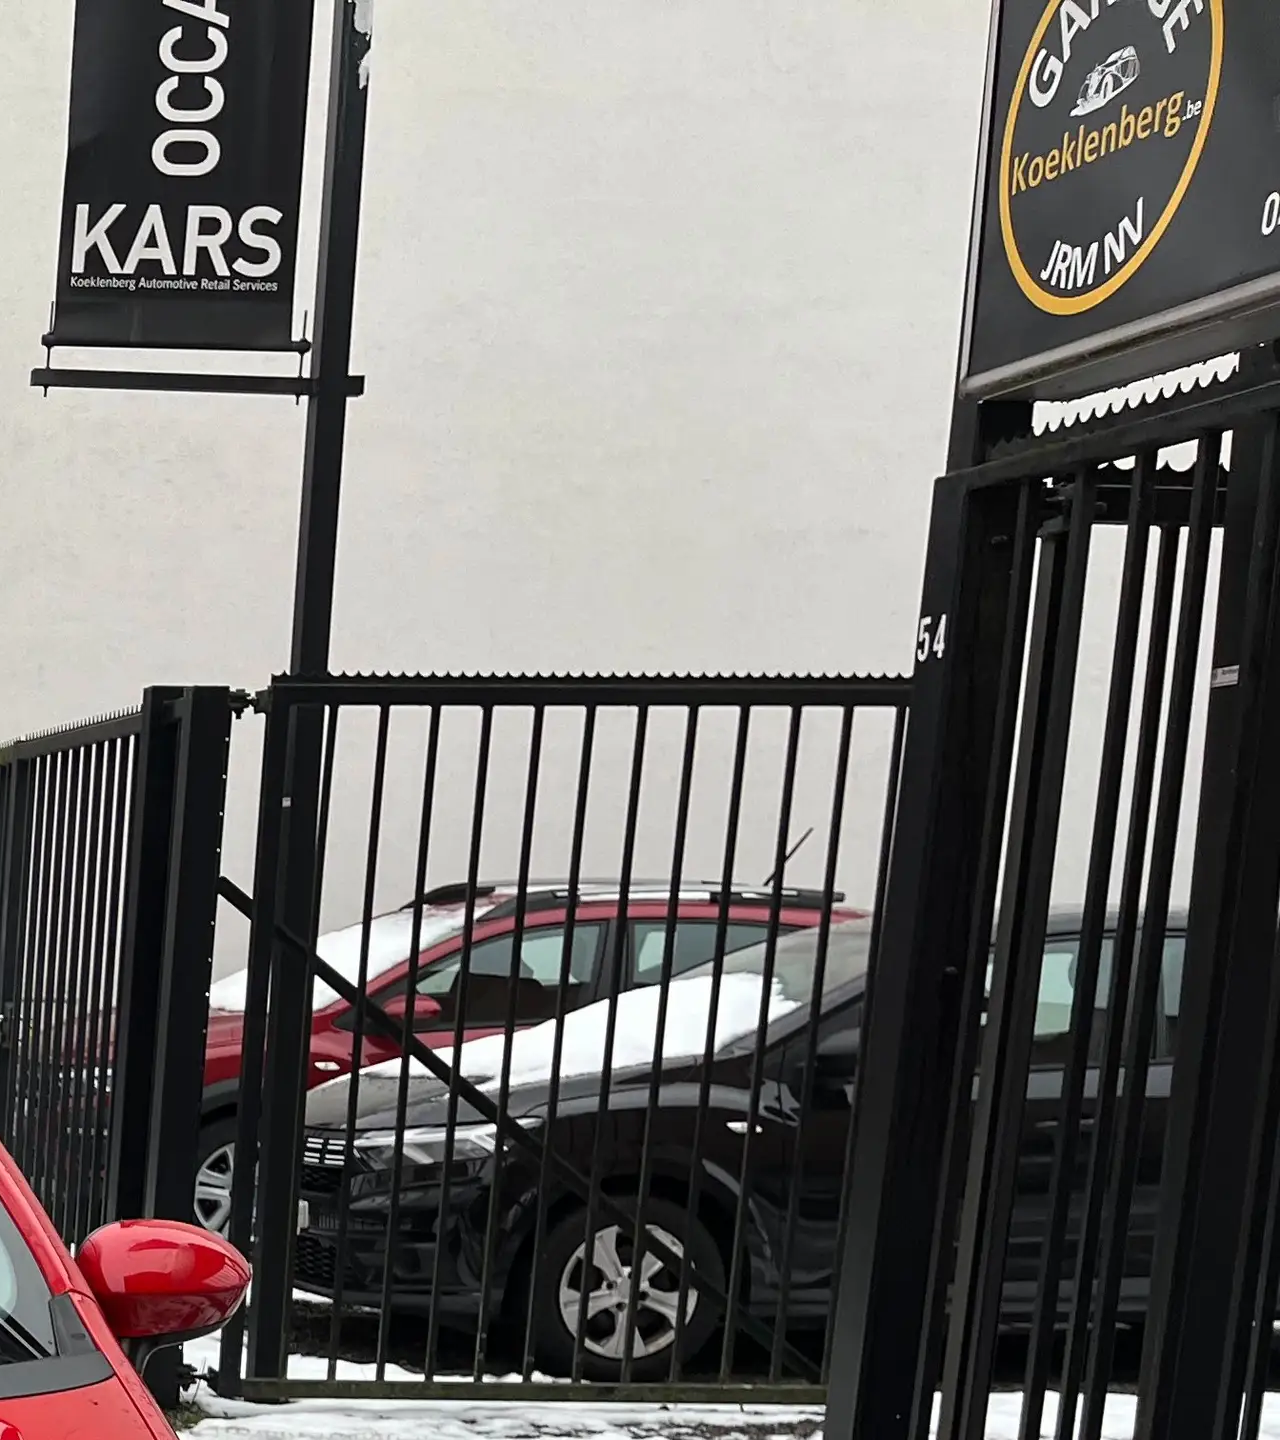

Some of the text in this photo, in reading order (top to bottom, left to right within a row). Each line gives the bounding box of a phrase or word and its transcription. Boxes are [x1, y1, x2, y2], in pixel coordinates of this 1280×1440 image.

[71, 203, 283, 278] KARS
[1040, 197, 1144, 290] JRM NV
[70, 276, 278, 291] Koeklenberg Automotive Retail Services
[917, 613, 947, 662] 54
